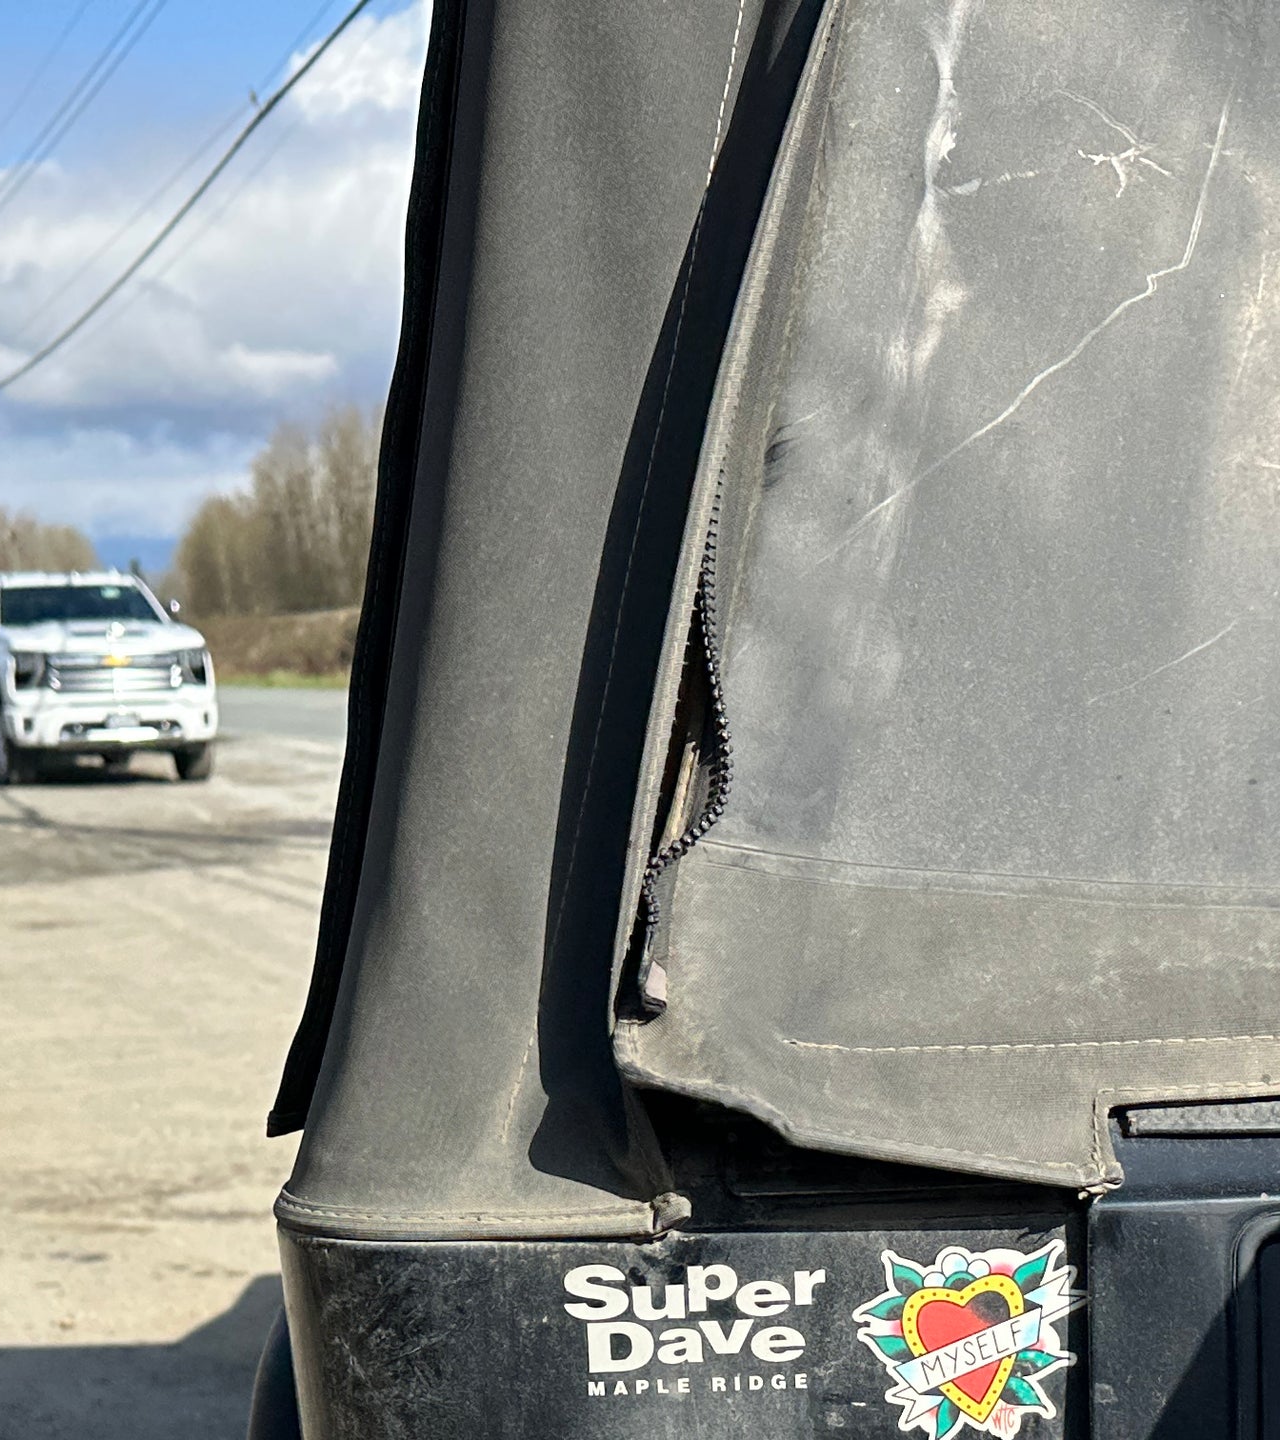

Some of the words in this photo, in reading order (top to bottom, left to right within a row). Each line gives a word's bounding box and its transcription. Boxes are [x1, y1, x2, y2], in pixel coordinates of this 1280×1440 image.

[920, 1319, 1022, 1386] MYSELF
[587, 1377, 691, 1397] MAPLE
[711, 1373, 809, 1392] RIDGE
